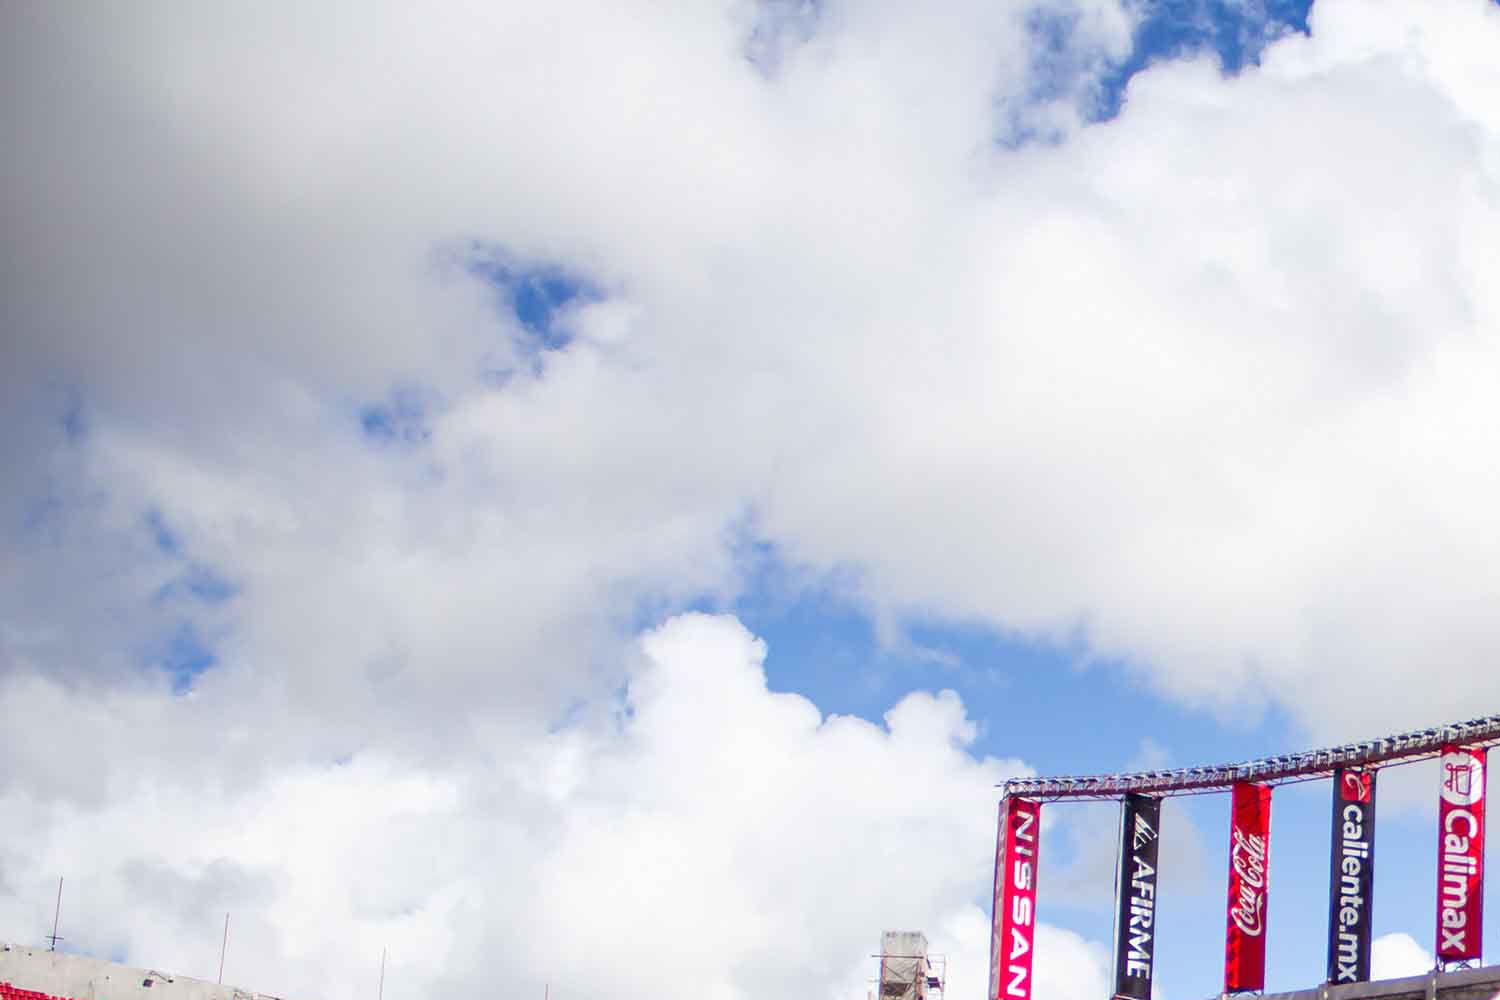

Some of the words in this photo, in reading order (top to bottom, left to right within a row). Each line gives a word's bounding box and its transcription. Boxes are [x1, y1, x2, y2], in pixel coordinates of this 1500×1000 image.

[1006, 809, 1034, 997] NISSAN
[1126, 855, 1156, 979] AFIRME
[1231, 825, 1266, 936] Coca-Cola
[1337, 804, 1369, 981] caliente.mx
[1441, 808, 1478, 952] Calimax
